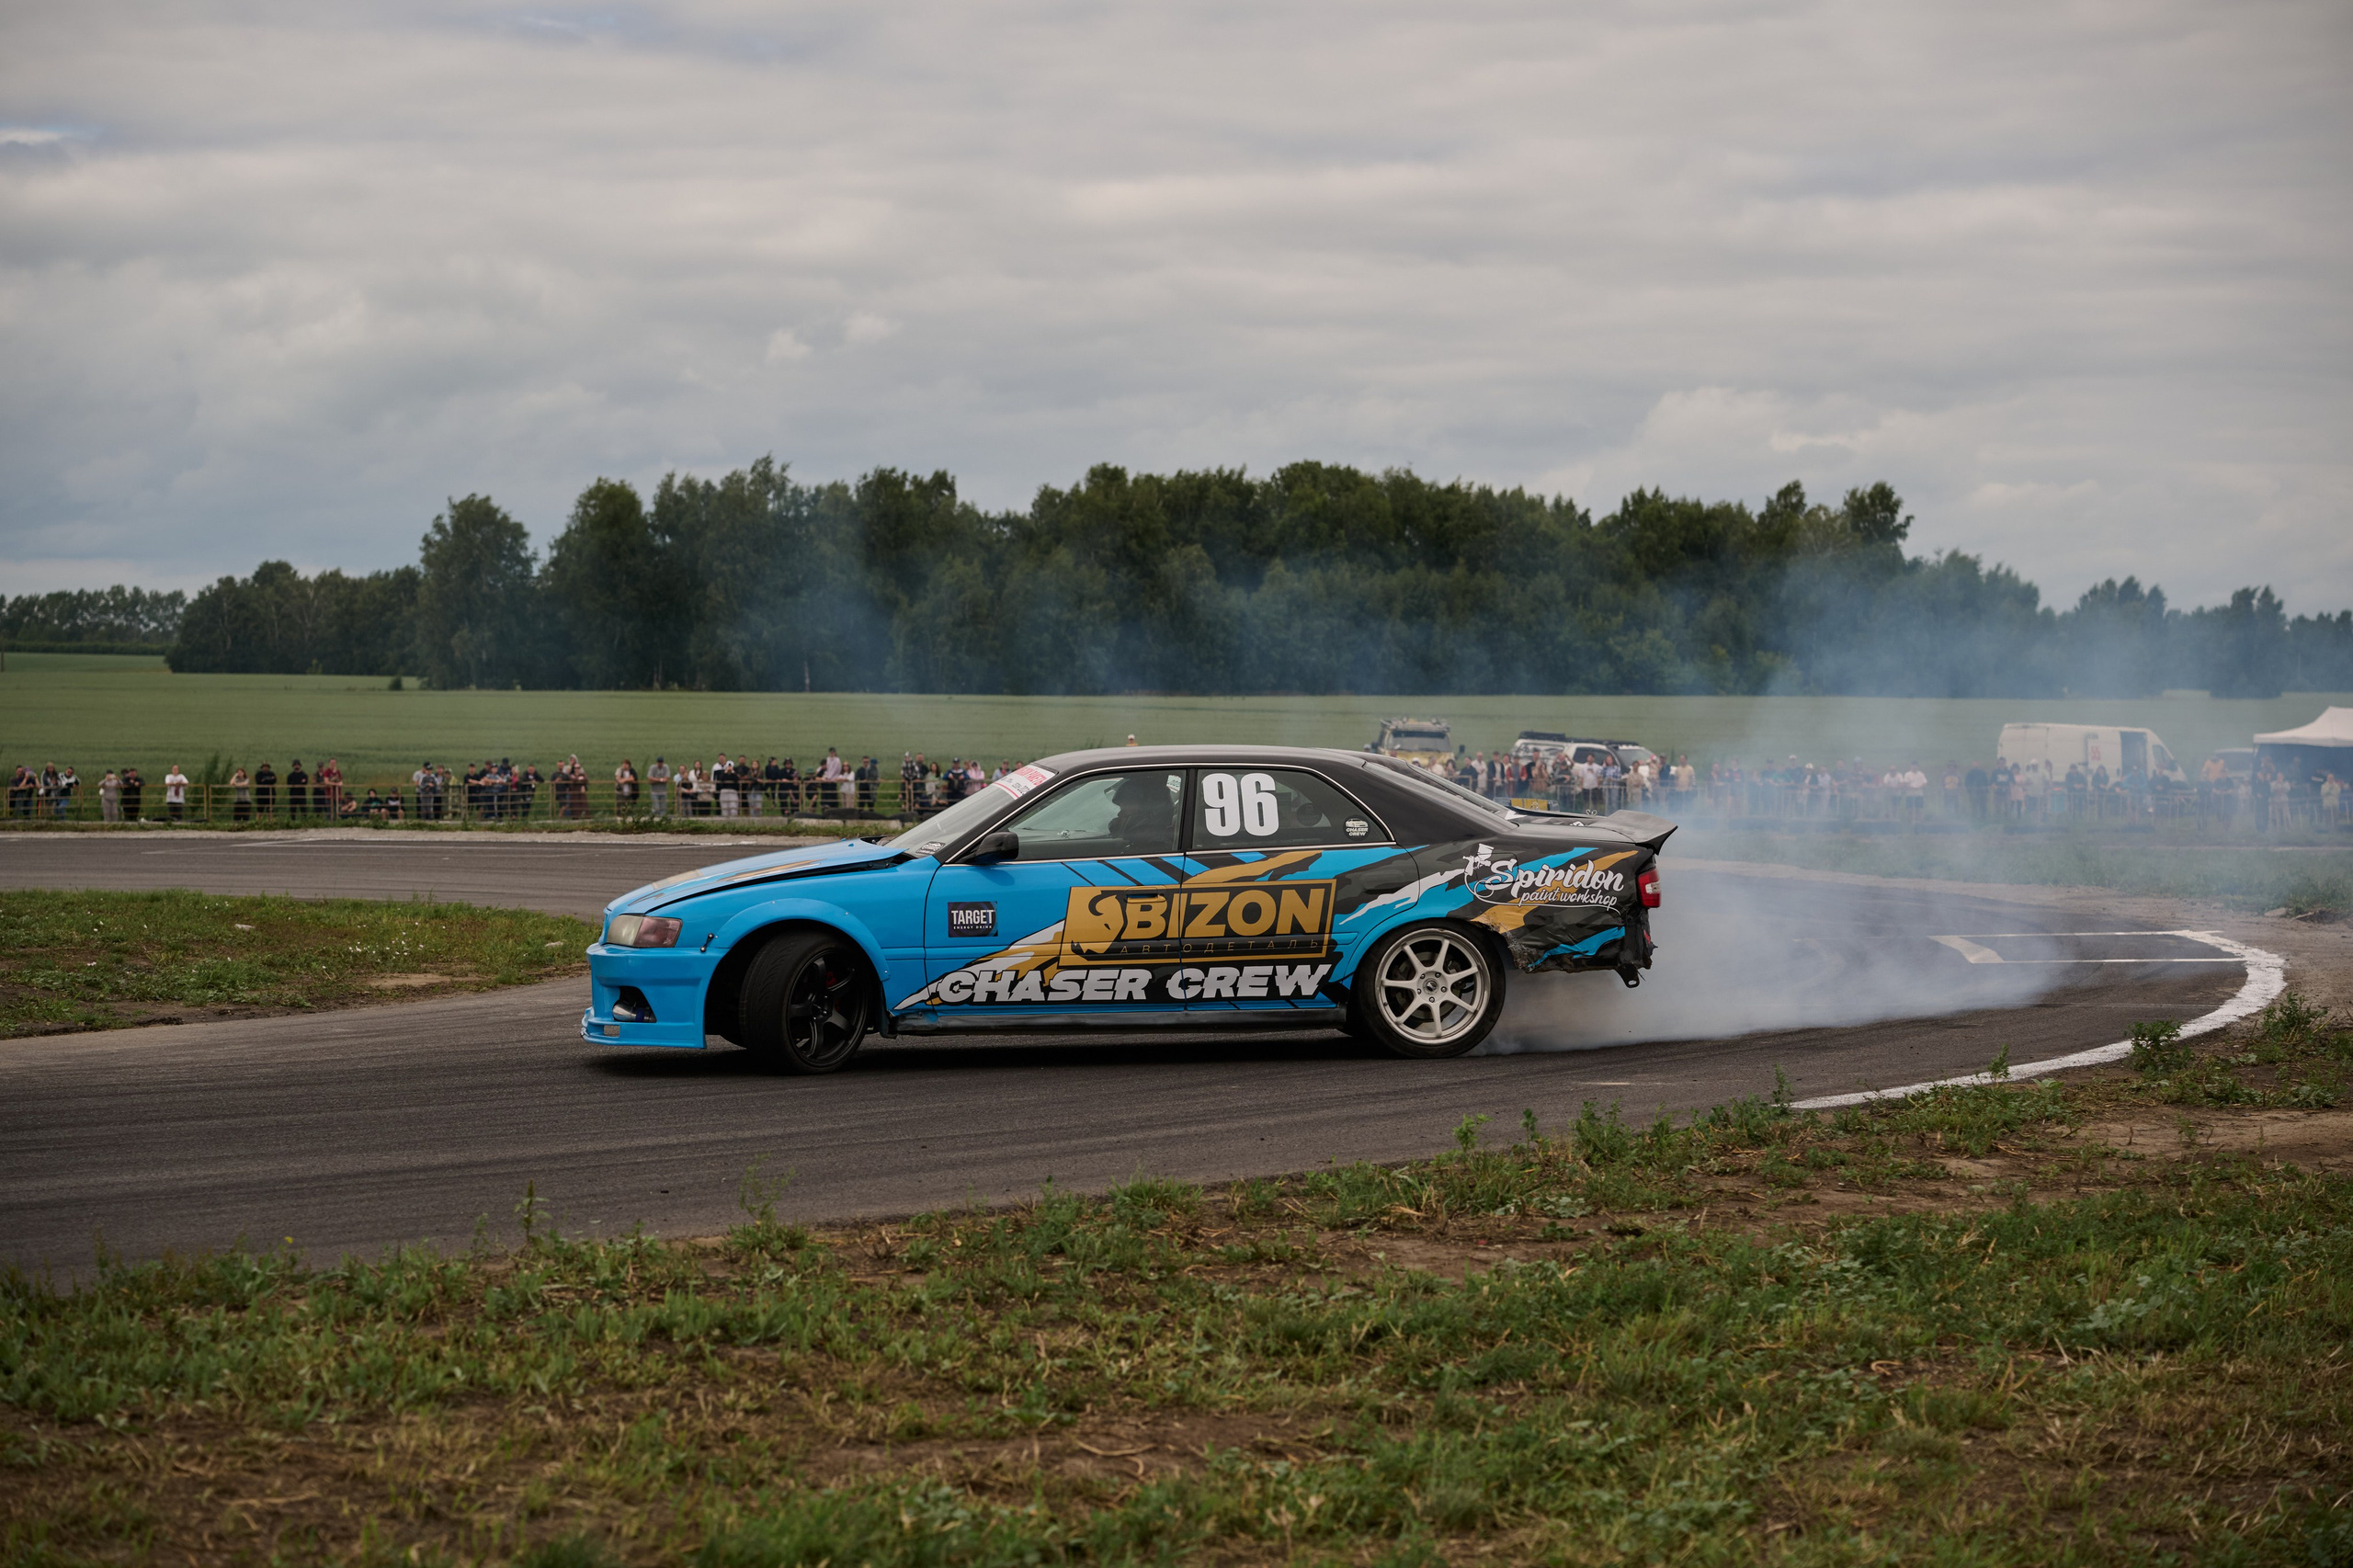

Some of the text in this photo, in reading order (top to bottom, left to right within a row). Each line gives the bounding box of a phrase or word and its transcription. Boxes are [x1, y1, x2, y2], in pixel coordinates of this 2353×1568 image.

[1201, 773, 1279, 836] 96
[1484, 858, 1624, 898] Spiridon
[951, 910, 994, 925] TARGET
[1120, 888, 1325, 940] BIZON
[1519, 887, 1618, 911] paint workshop
[1120, 938, 1319, 955] АВТОДЕТАЛЬ
[938, 964, 1333, 1003] CHASER CREW
